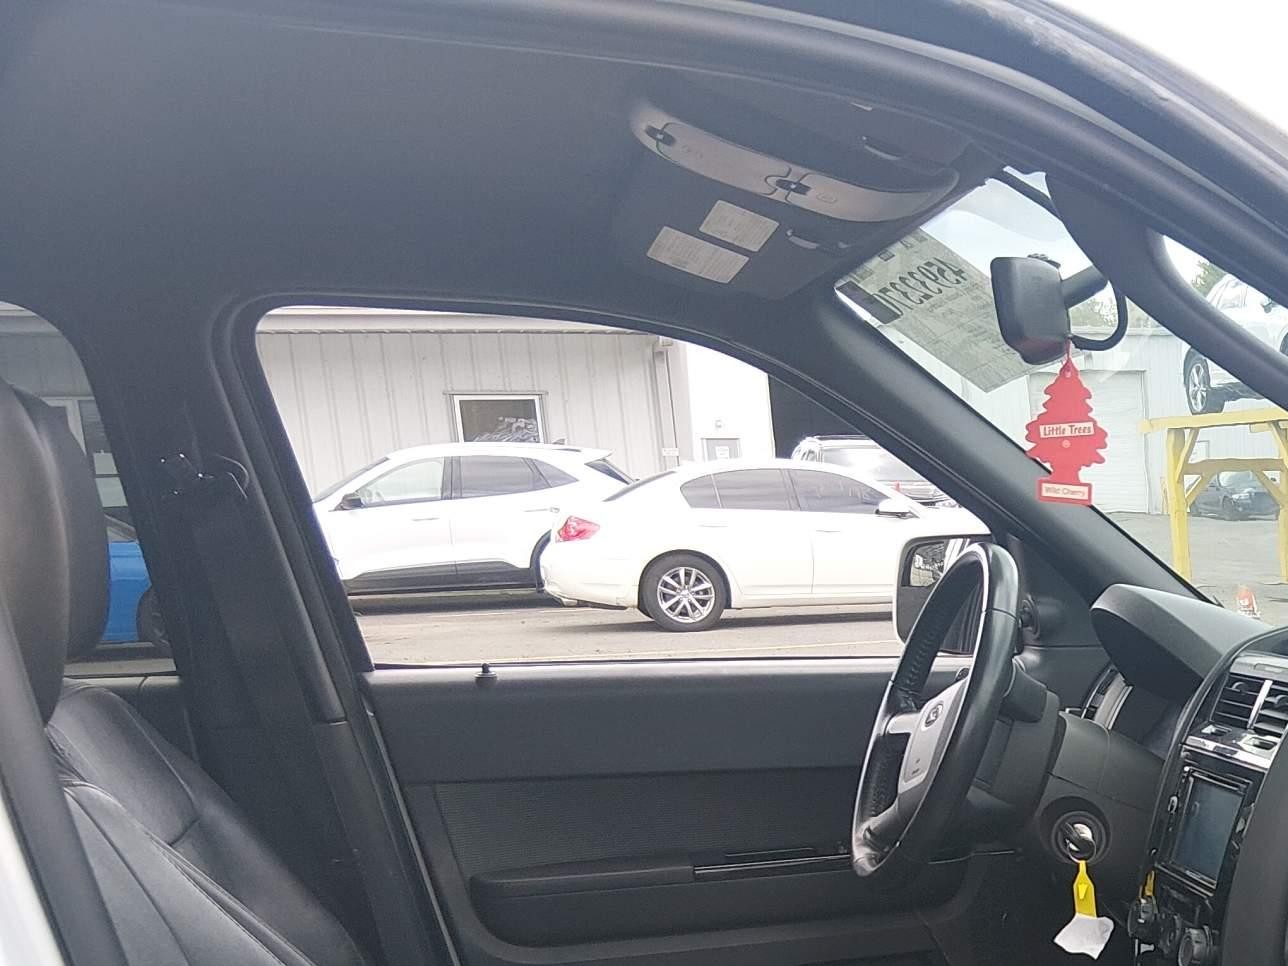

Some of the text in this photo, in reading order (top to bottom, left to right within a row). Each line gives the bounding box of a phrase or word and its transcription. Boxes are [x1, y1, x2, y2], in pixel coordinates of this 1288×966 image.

[1043, 424, 1092, 437] Little Trees
[1044, 486, 1086, 498] Wild Cherry
